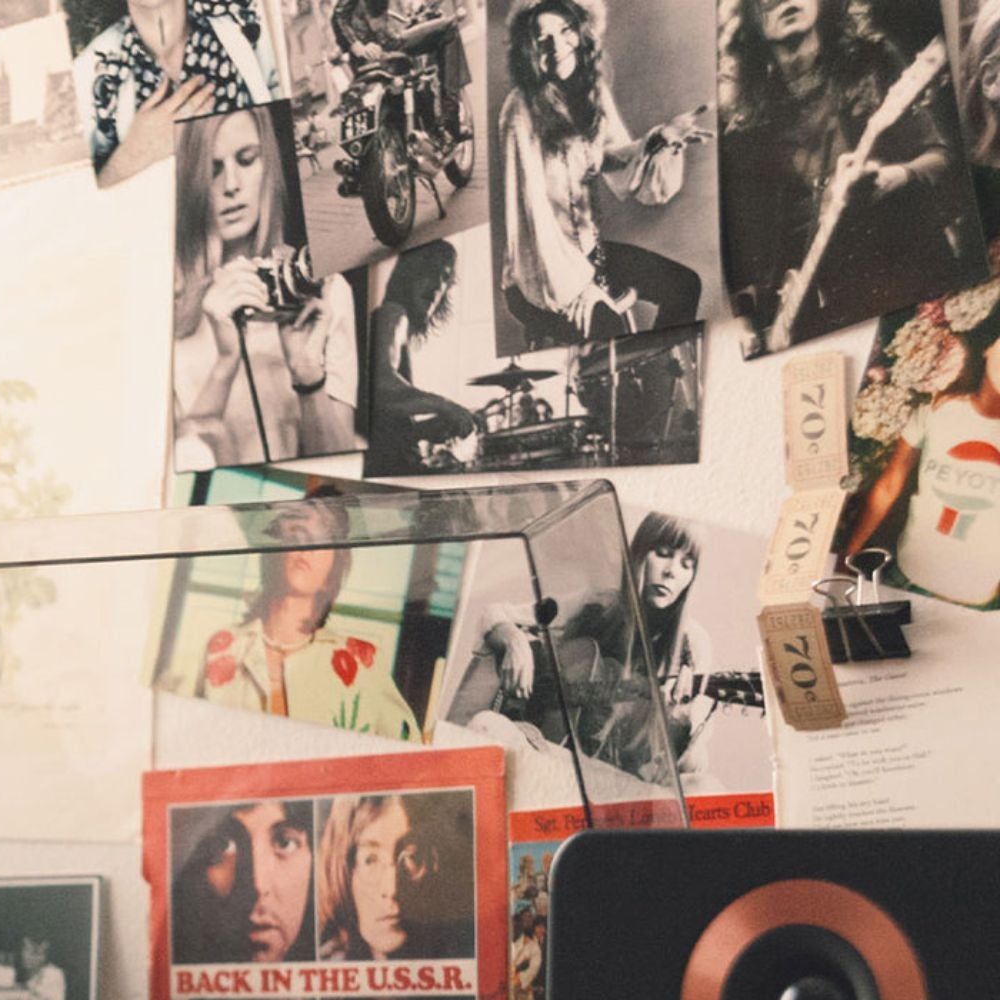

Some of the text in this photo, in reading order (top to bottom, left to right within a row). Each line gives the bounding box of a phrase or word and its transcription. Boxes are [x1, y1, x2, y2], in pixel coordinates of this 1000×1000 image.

[734, 801, 770, 818] Club
[177, 964, 473, 994] BACK IN THE U.S.S.R.
